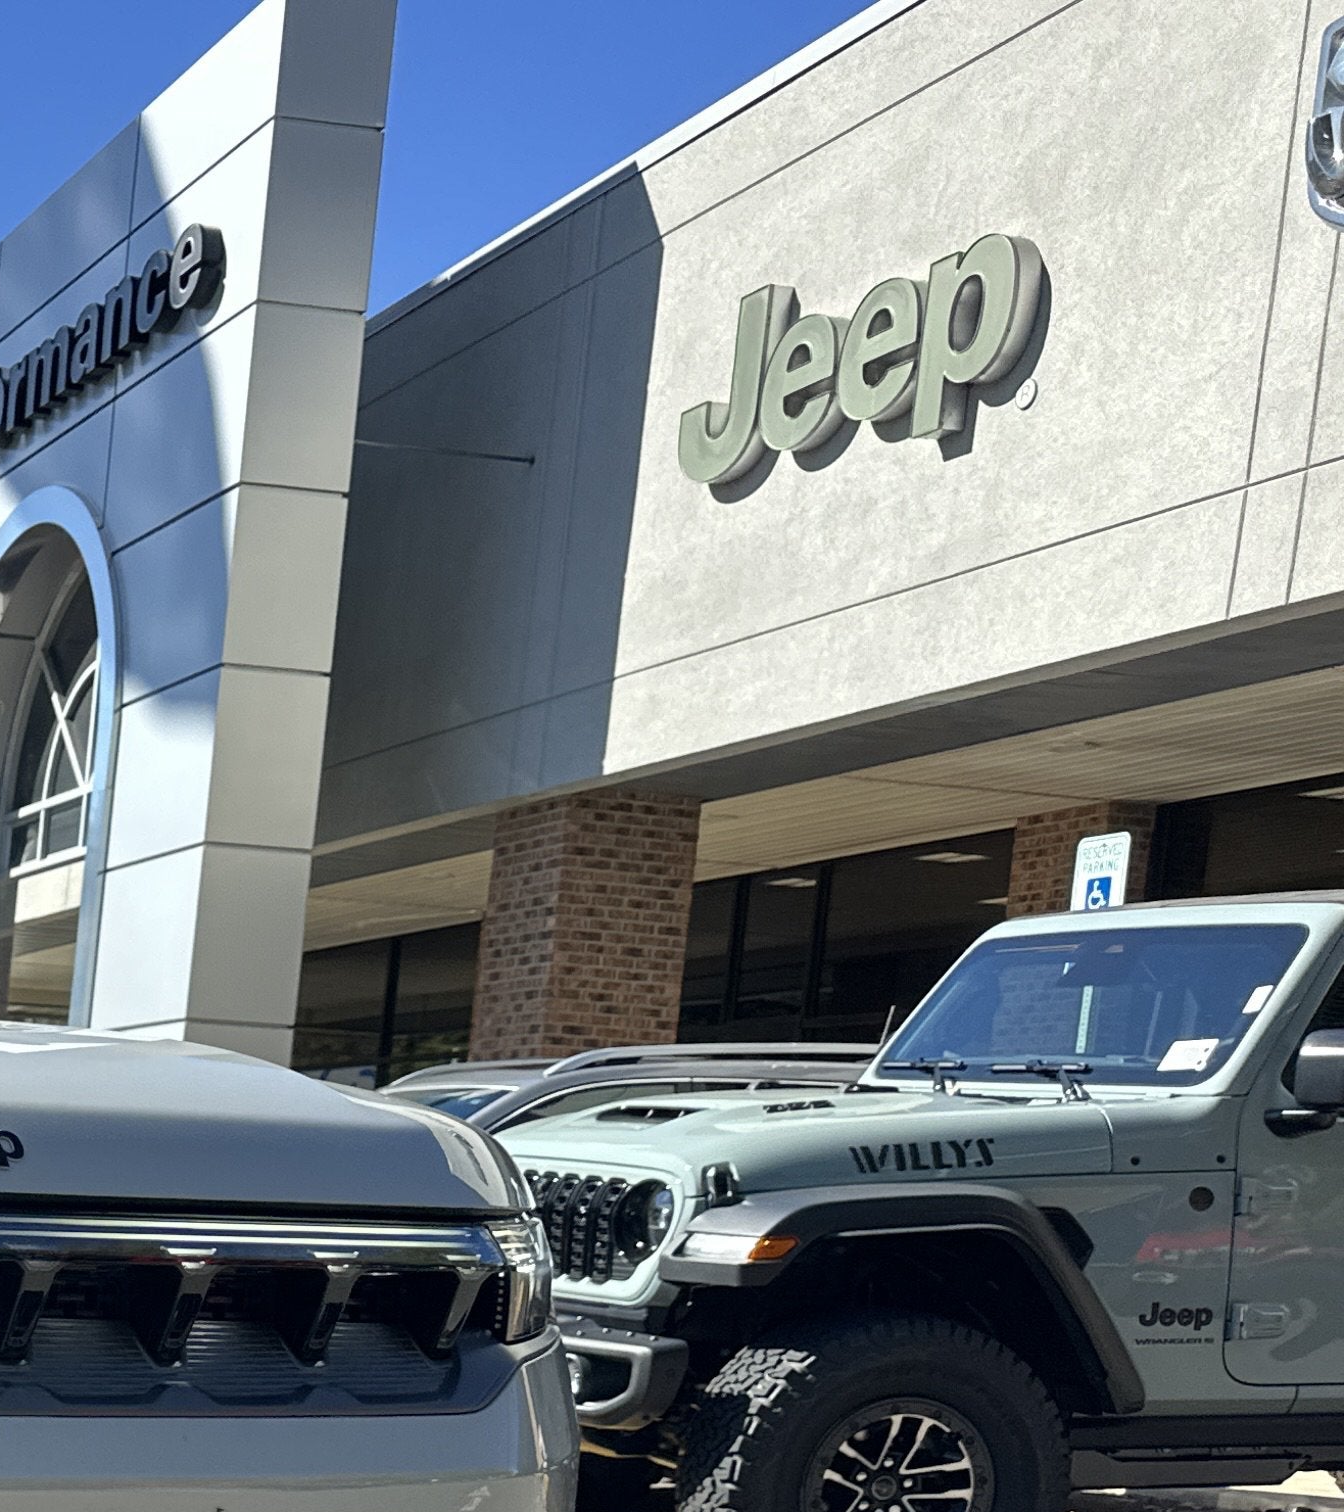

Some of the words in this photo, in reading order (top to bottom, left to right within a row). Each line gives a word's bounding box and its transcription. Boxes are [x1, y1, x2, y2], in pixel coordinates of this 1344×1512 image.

[678, 233, 1043, 483] Jeep
[1082, 858, 1120, 874] PARKING
[848, 1137, 995, 1174] WILLYS
[1139, 1302, 1213, 1331] Jeep
